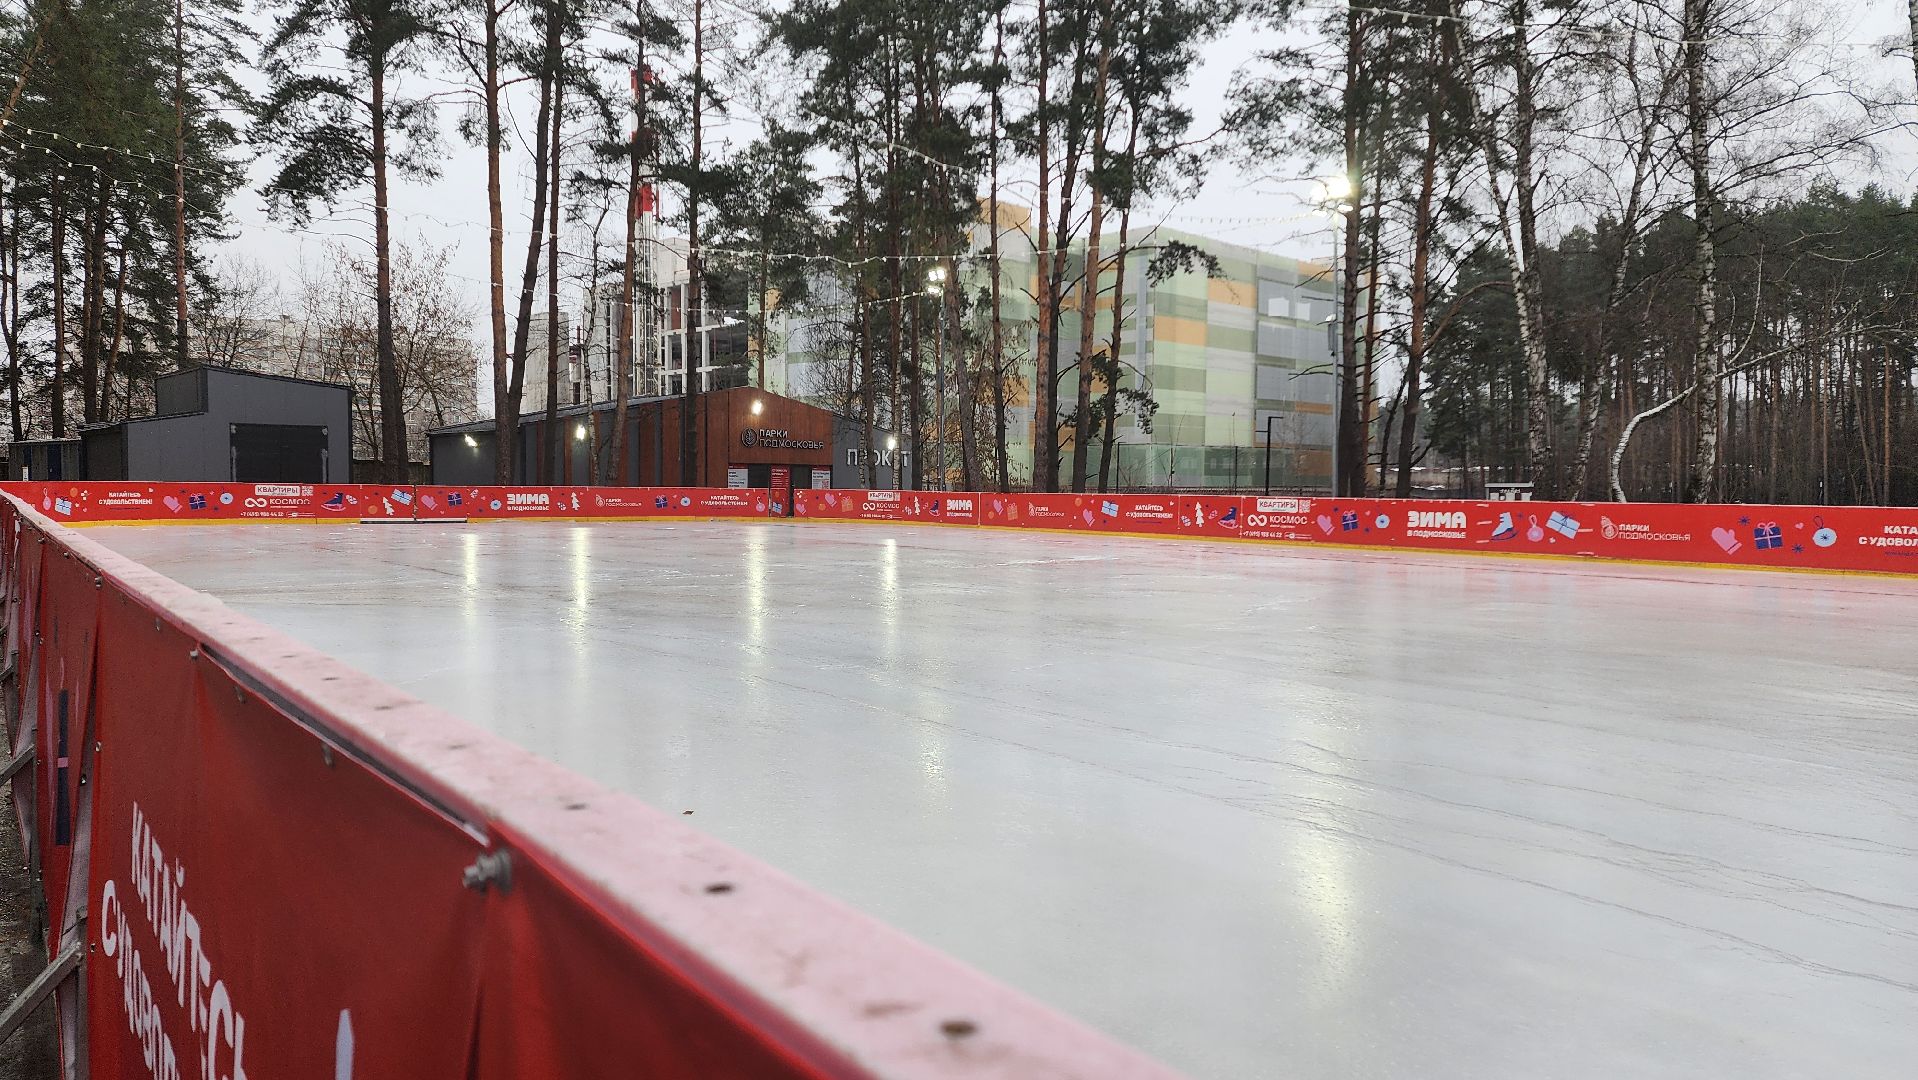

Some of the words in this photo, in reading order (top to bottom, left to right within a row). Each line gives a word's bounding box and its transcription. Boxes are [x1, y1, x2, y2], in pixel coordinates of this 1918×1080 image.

[759, 428, 788, 438] ПАРКИ
[759, 438, 824, 449] ПОДМОСКОВЬЯ
[257, 486, 298, 494] КВАРТИРЫ
[506, 494, 550, 505] ЗИМА
[946, 499, 973, 511] ЗИМА
[1259, 501, 1296, 509] КВАРТИРЫ
[1269, 515, 1308, 525] КОСМОС
[1407, 510, 1467, 529] ЗИМА
[1619, 523, 1650, 532] ПАРКИ
[1618, 532, 1691, 542] ПОДМОСКОВЬЯ
[1858, 536, 1868, 545] С
